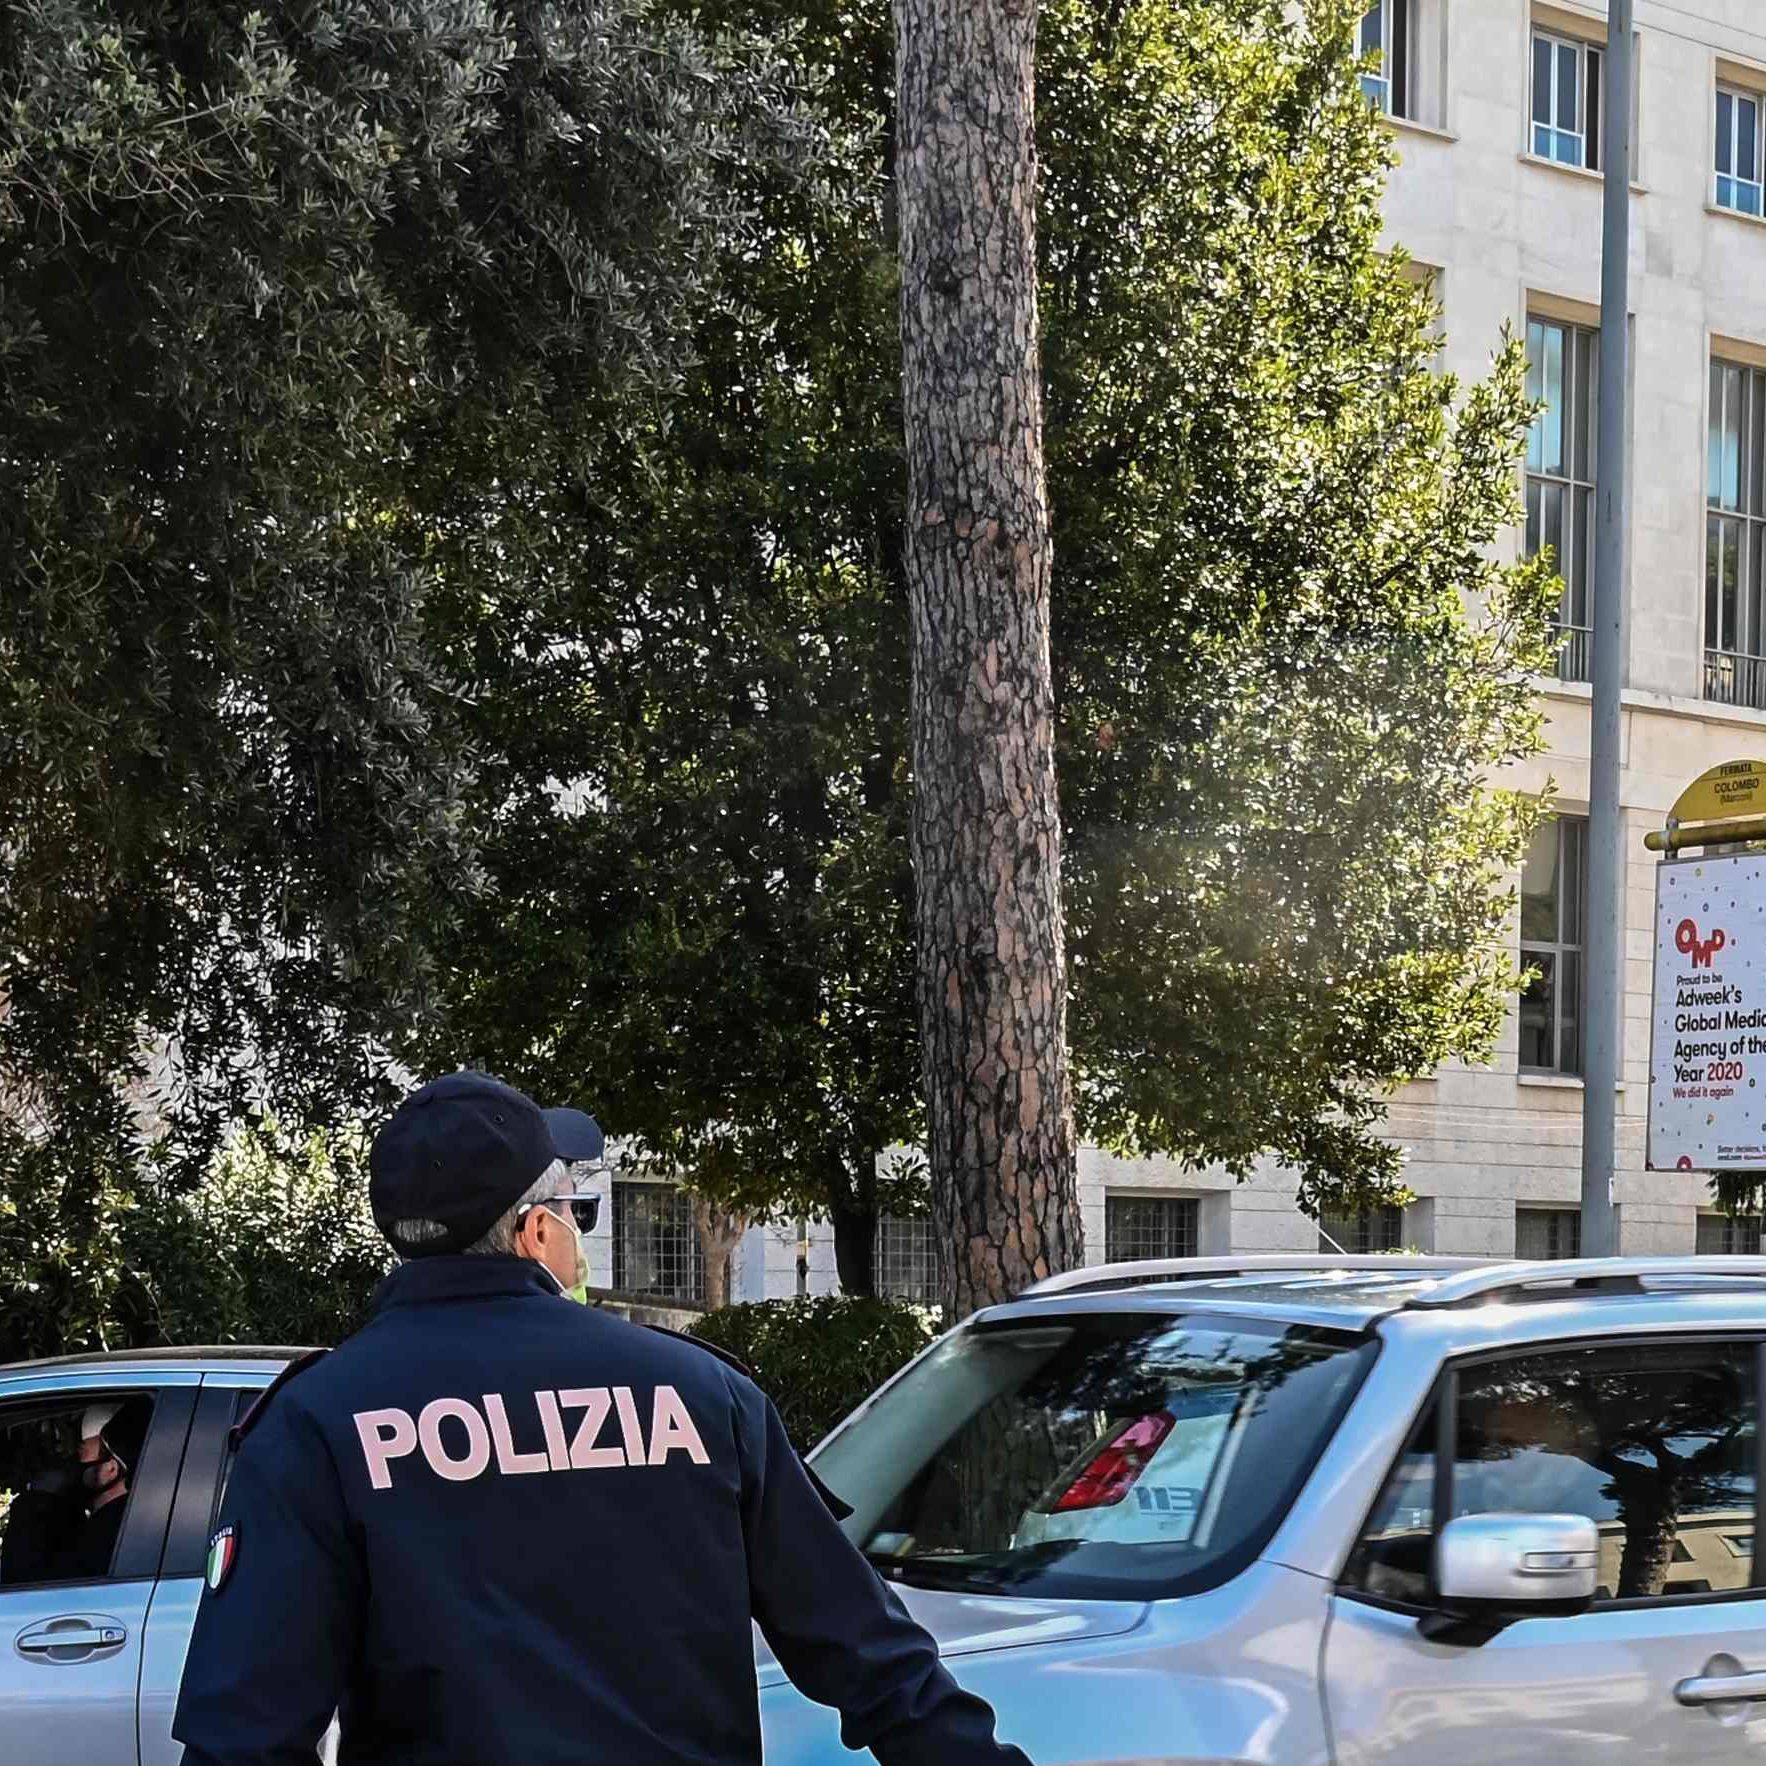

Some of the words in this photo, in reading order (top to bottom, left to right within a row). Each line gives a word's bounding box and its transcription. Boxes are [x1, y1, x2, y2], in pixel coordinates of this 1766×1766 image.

[1714, 778, 1759, 794] COLOMBO
[1676, 974, 1700, 986] Proud
[1702, 975, 1711, 984] to
[1712, 972, 1723, 983] be
[1676, 984, 1742, 1008] Adweek's
[1675, 1012, 1721, 1032] Global
[1674, 1040, 1727, 1062] Agency
[1730, 1036, 1745, 1055] of
[1674, 1064, 1704, 1083] Year
[1707, 1062, 1743, 1081] 2020
[1673, 1088, 1686, 1099] We
[1688, 1086, 1701, 1098] did
[1702, 1086, 1708, 1098] it
[1709, 1088, 1734, 1101] again
[353, 1385, 711, 1489] POLIZIA
